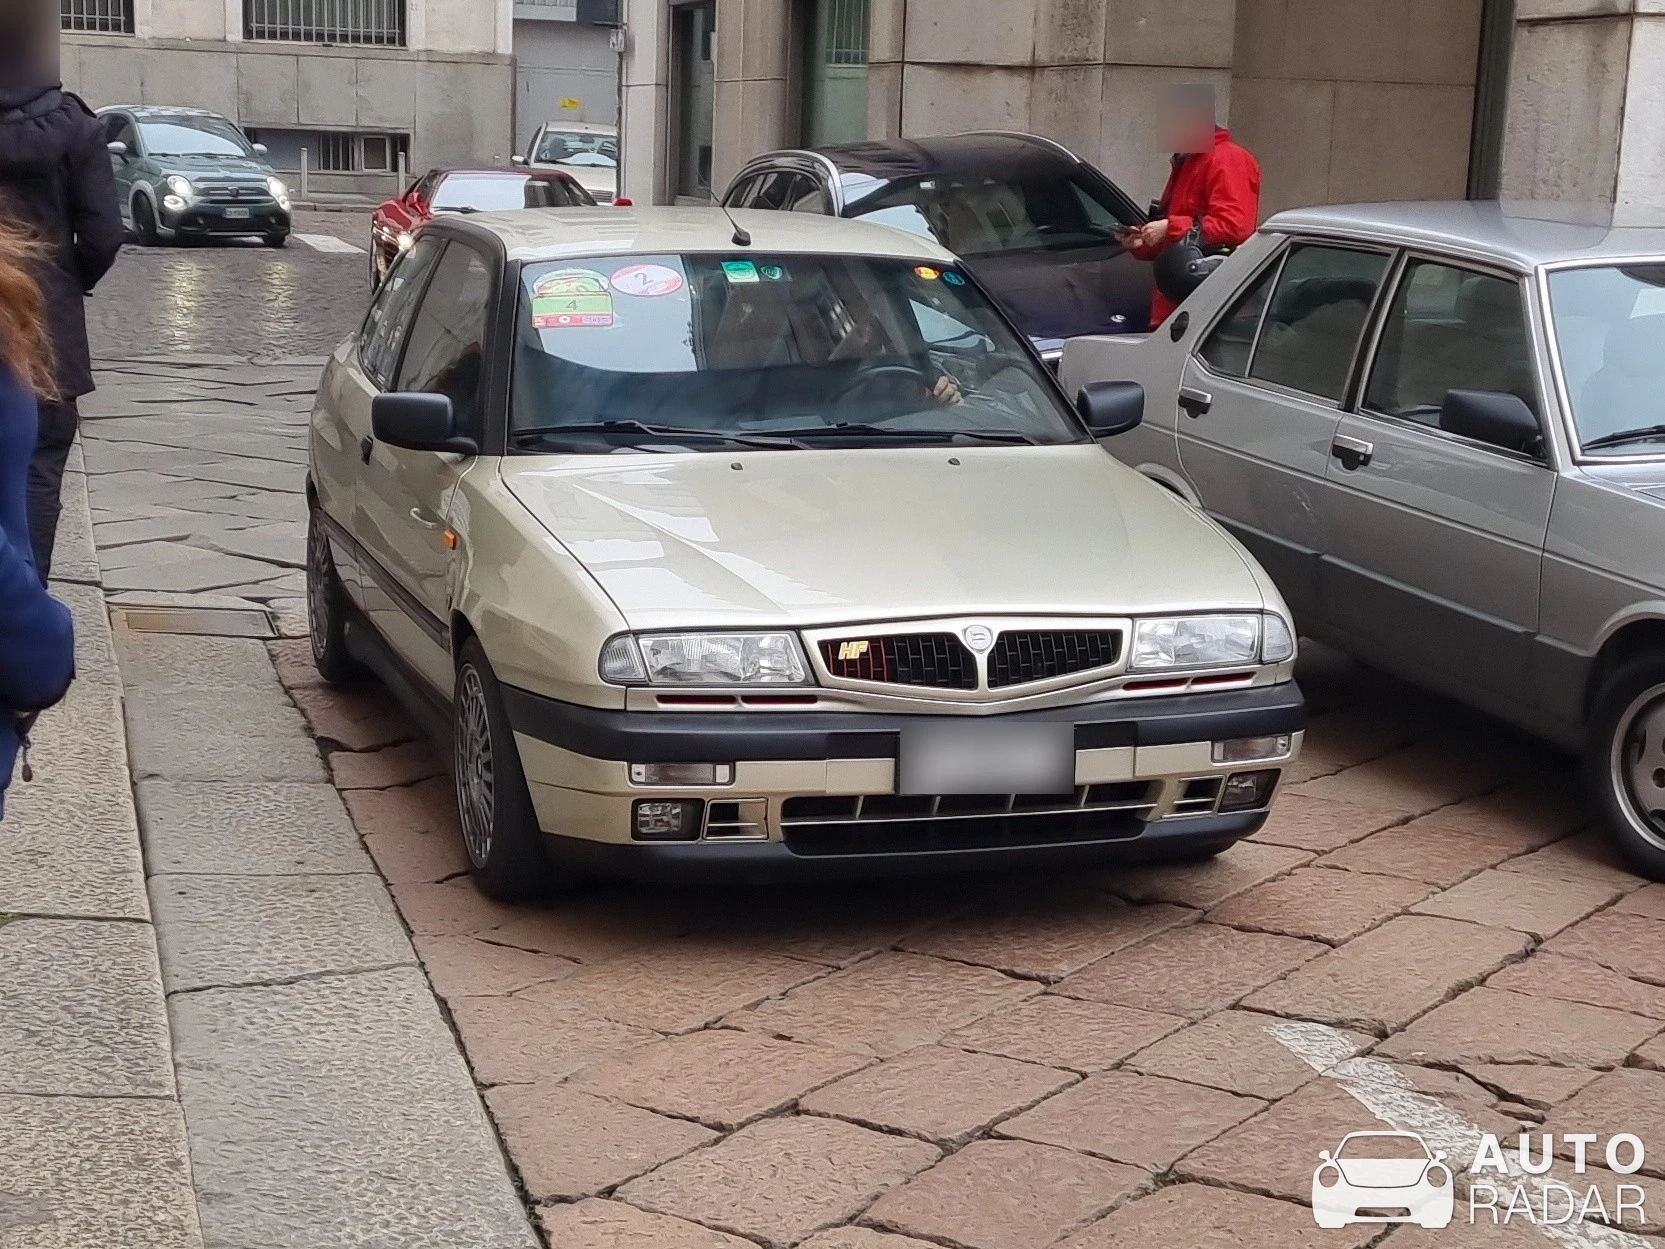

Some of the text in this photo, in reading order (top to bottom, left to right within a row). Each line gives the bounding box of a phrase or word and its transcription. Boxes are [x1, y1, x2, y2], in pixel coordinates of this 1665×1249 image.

[634, 272, 654, 286] 2
[566, 299, 578, 310] 4
[838, 640, 869, 660] HF
